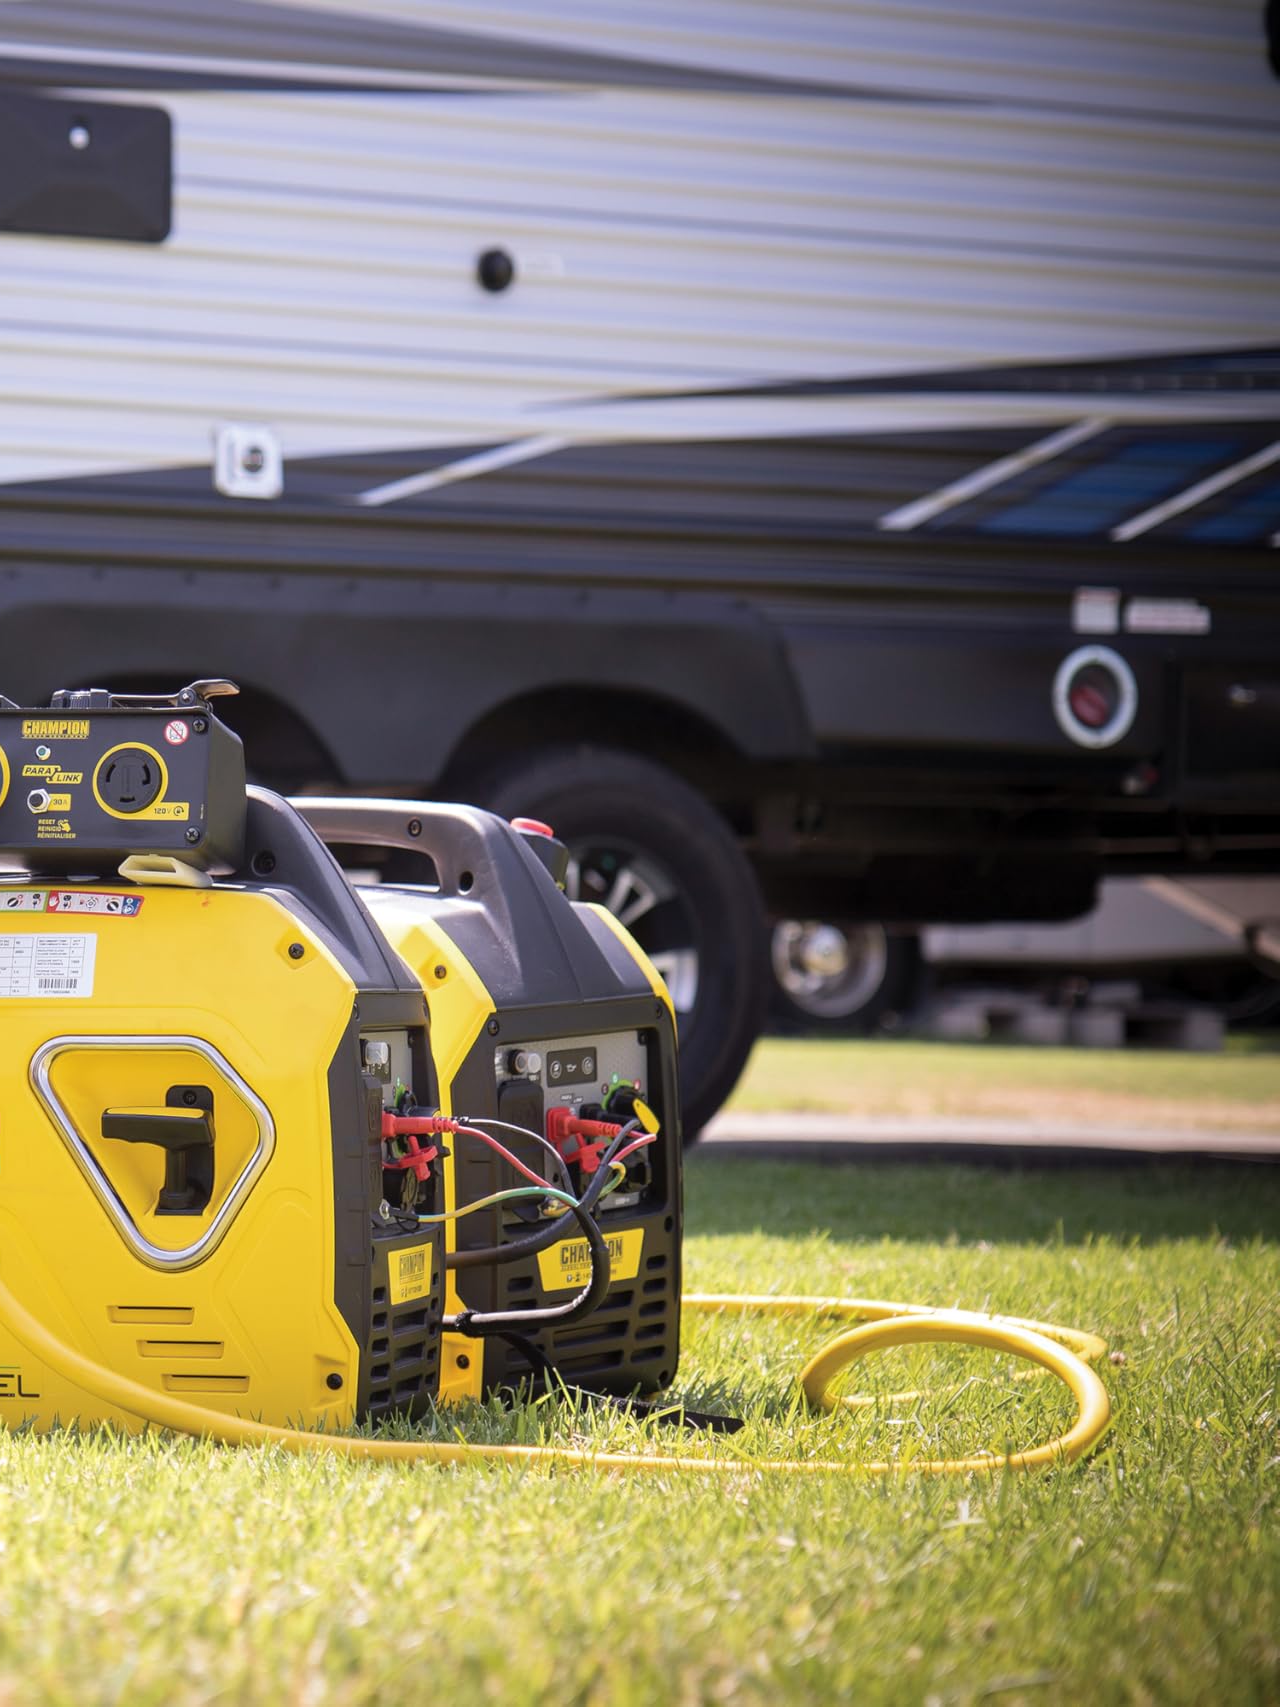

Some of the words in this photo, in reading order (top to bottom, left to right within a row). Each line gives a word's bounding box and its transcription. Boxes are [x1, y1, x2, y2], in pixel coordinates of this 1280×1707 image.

[22, 720, 90, 736] CHAMPION
[24, 767, 52, 775] PARA
[56, 774, 81, 782] LINK
